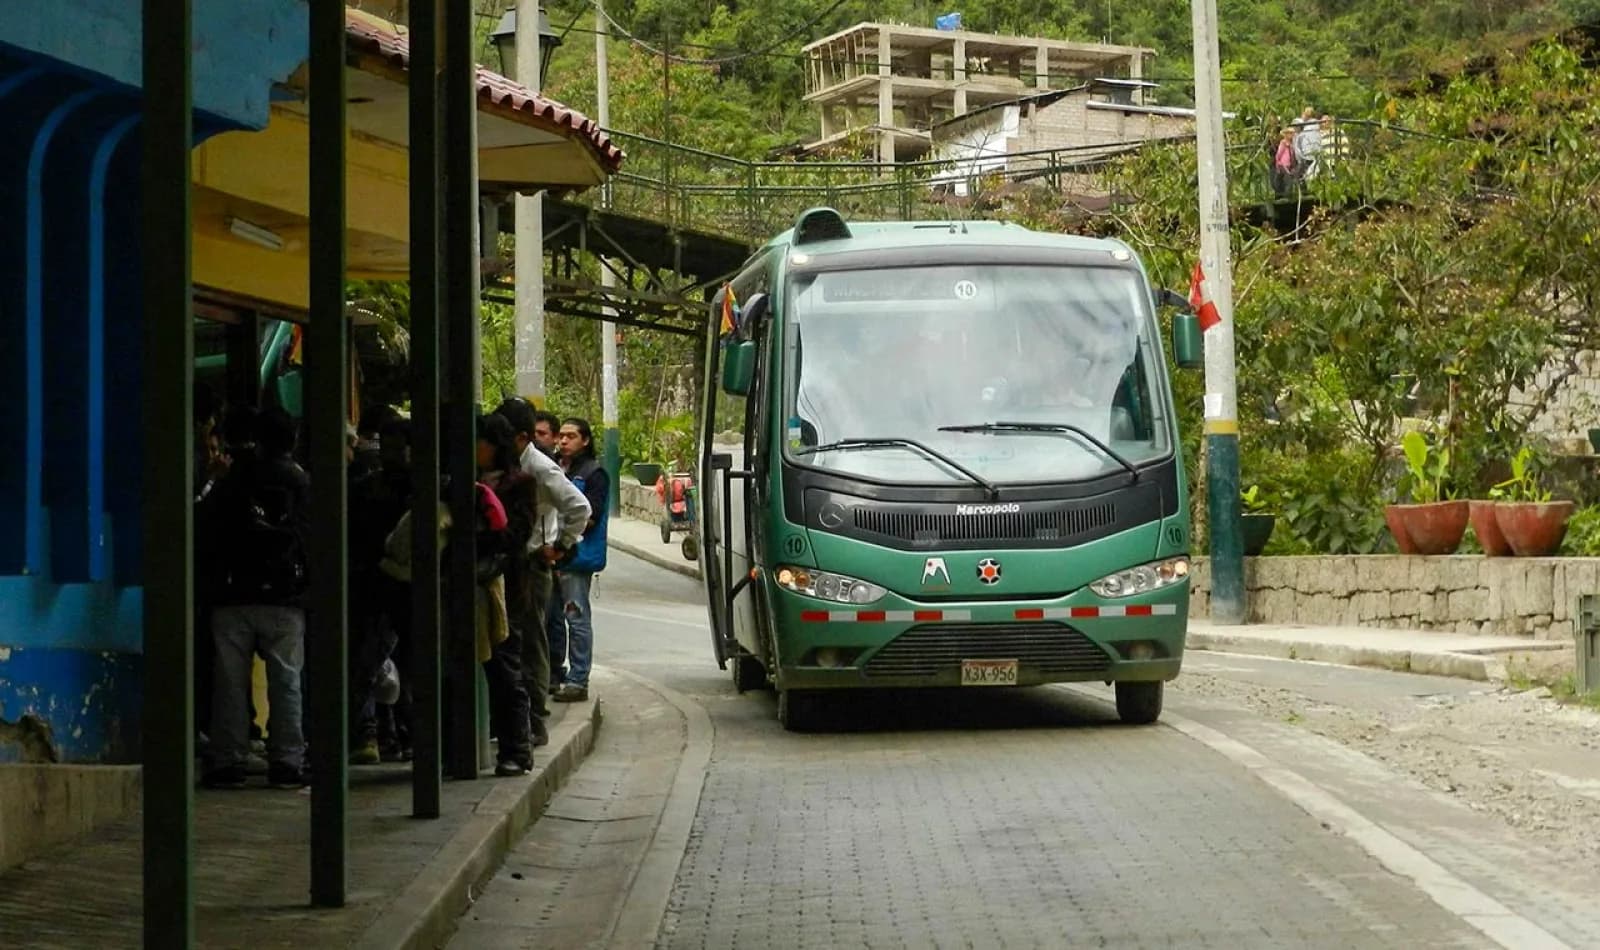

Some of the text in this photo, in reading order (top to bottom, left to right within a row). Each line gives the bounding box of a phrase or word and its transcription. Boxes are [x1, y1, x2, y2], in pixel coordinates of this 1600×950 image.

[957, 283, 974, 297] 10
[956, 503, 1020, 516] Marcopolo
[1169, 527, 1182, 544] 10
[788, 537, 802, 554] 10
[964, 666, 1015, 681] X3X-956
